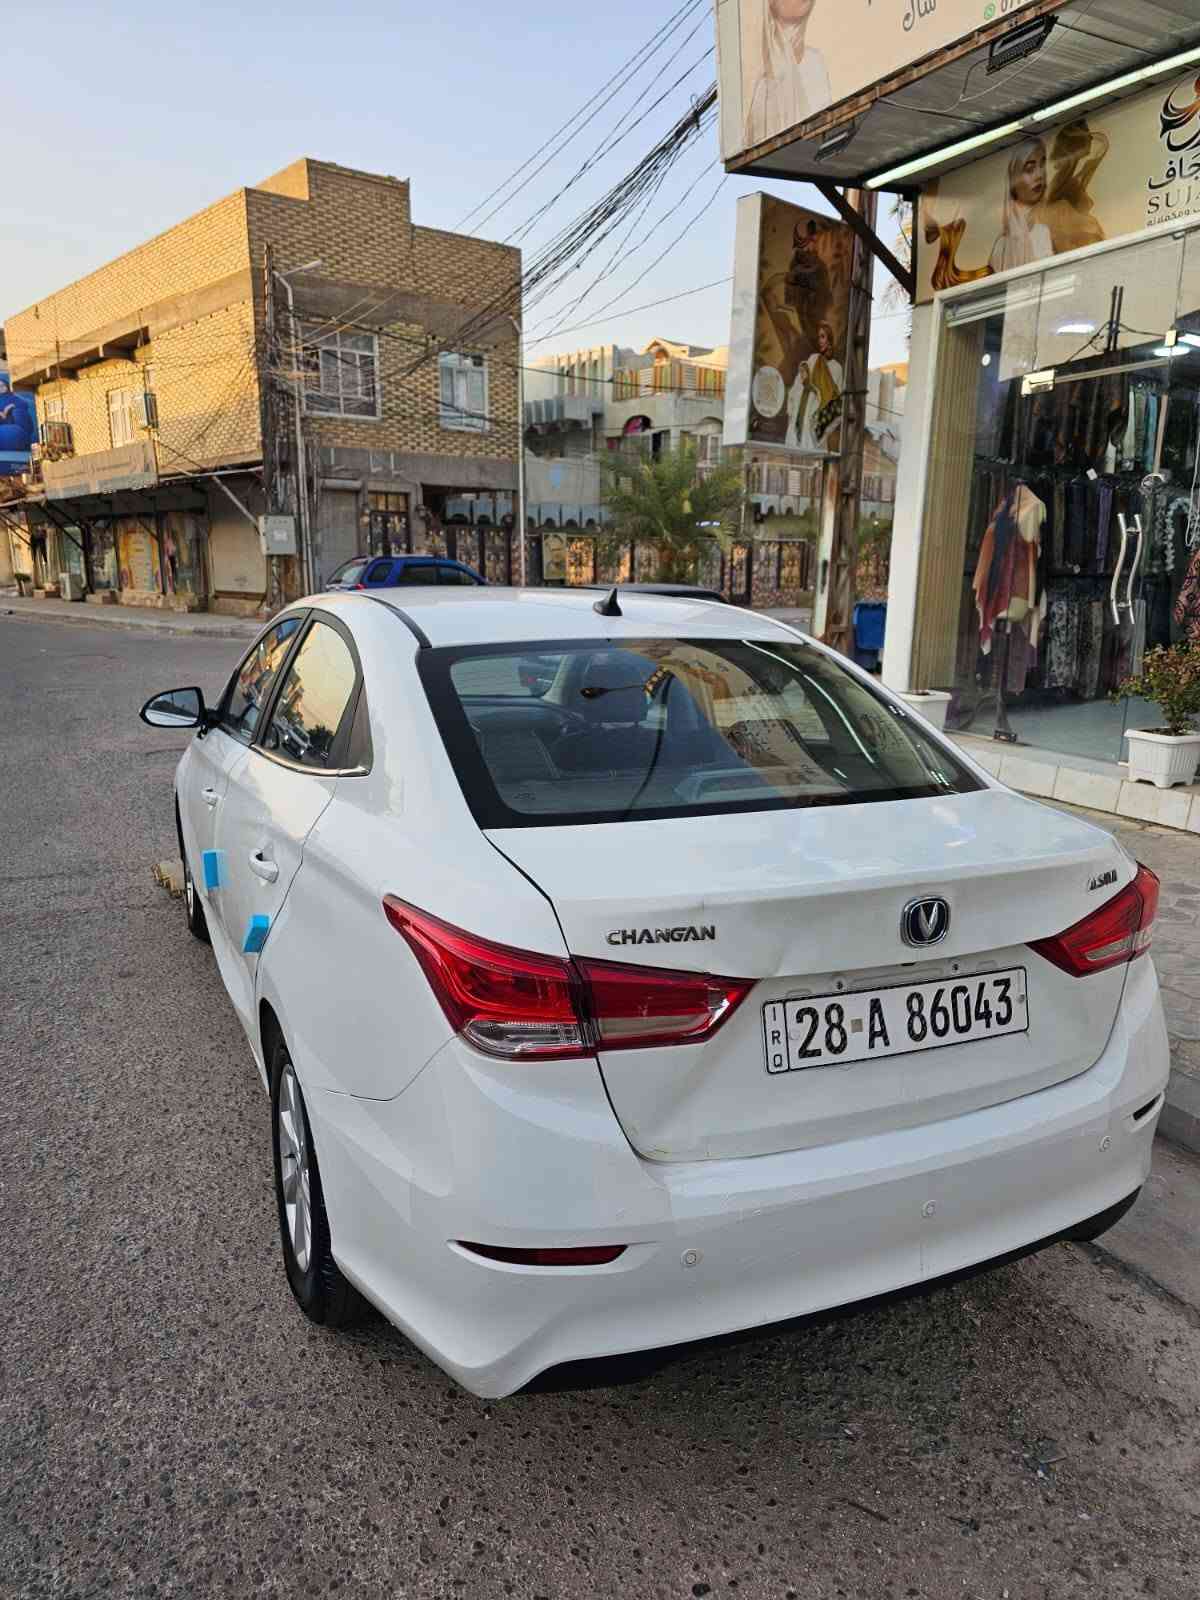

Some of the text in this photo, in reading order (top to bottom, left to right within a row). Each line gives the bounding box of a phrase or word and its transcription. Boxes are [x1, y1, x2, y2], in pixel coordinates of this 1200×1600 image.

[607, 925, 716, 946] CHANGAN
[795, 977, 1014, 1059] 28 A 86043
